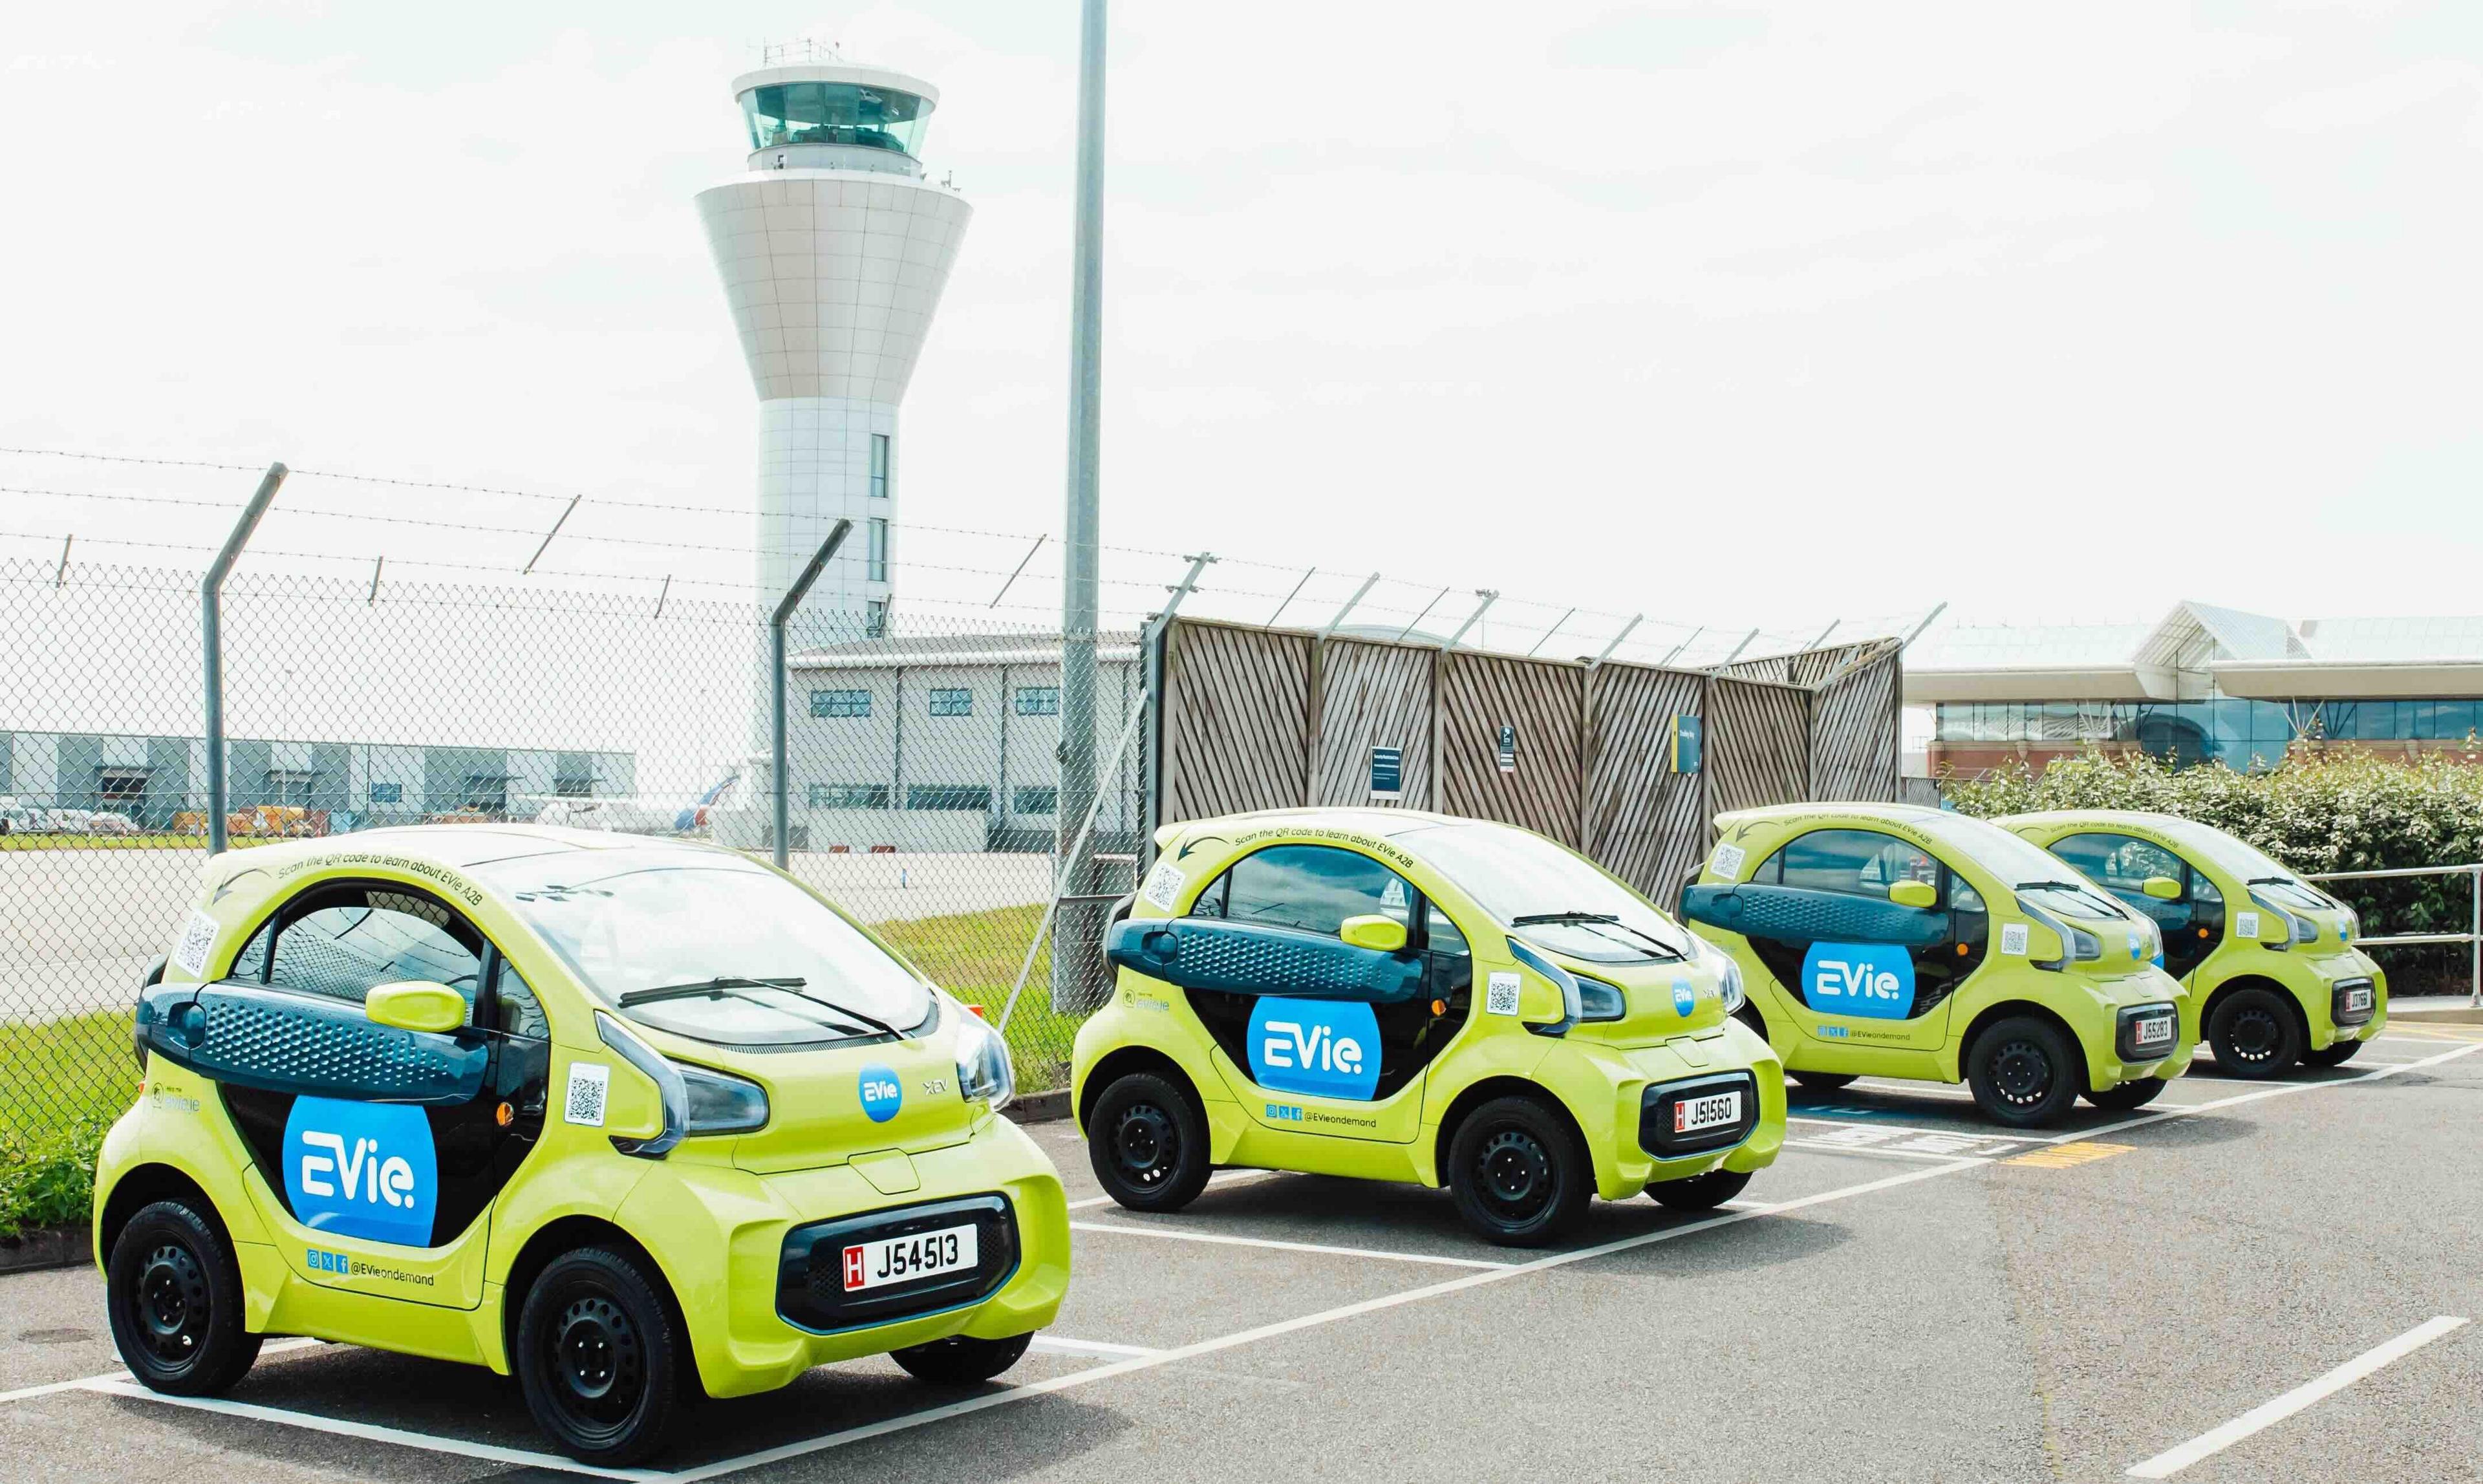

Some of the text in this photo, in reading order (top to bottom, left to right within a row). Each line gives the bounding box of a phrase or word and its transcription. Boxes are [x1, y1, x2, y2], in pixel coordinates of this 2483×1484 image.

[1880, 819, 1902, 828] about
[1918, 833, 1933, 844] A2B
[1235, 833, 1256, 846] Scan
[1260, 829, 1273, 837] the
[1276, 828, 1289, 837] QR
[1315, 828, 1324, 837] to
[1326, 829, 1349, 841] learn
[1350, 834, 1377, 848] about
[1377, 843, 1396, 857] EVie
[1395, 854, 1414, 868] A2B
[278, 852, 484, 907] Scan the QR code to learn about EVie A2B
[2144, 1020, 2168, 1040] J55283
[921, 1076, 948, 1096] XEV
[1304, 1112, 1377, 1128] @EVieondemand
[1676, 1097, 1732, 1129] H J51560
[846, 1234, 958, 1284] H J54513
[350, 1262, 435, 1286] @EVieondemand
